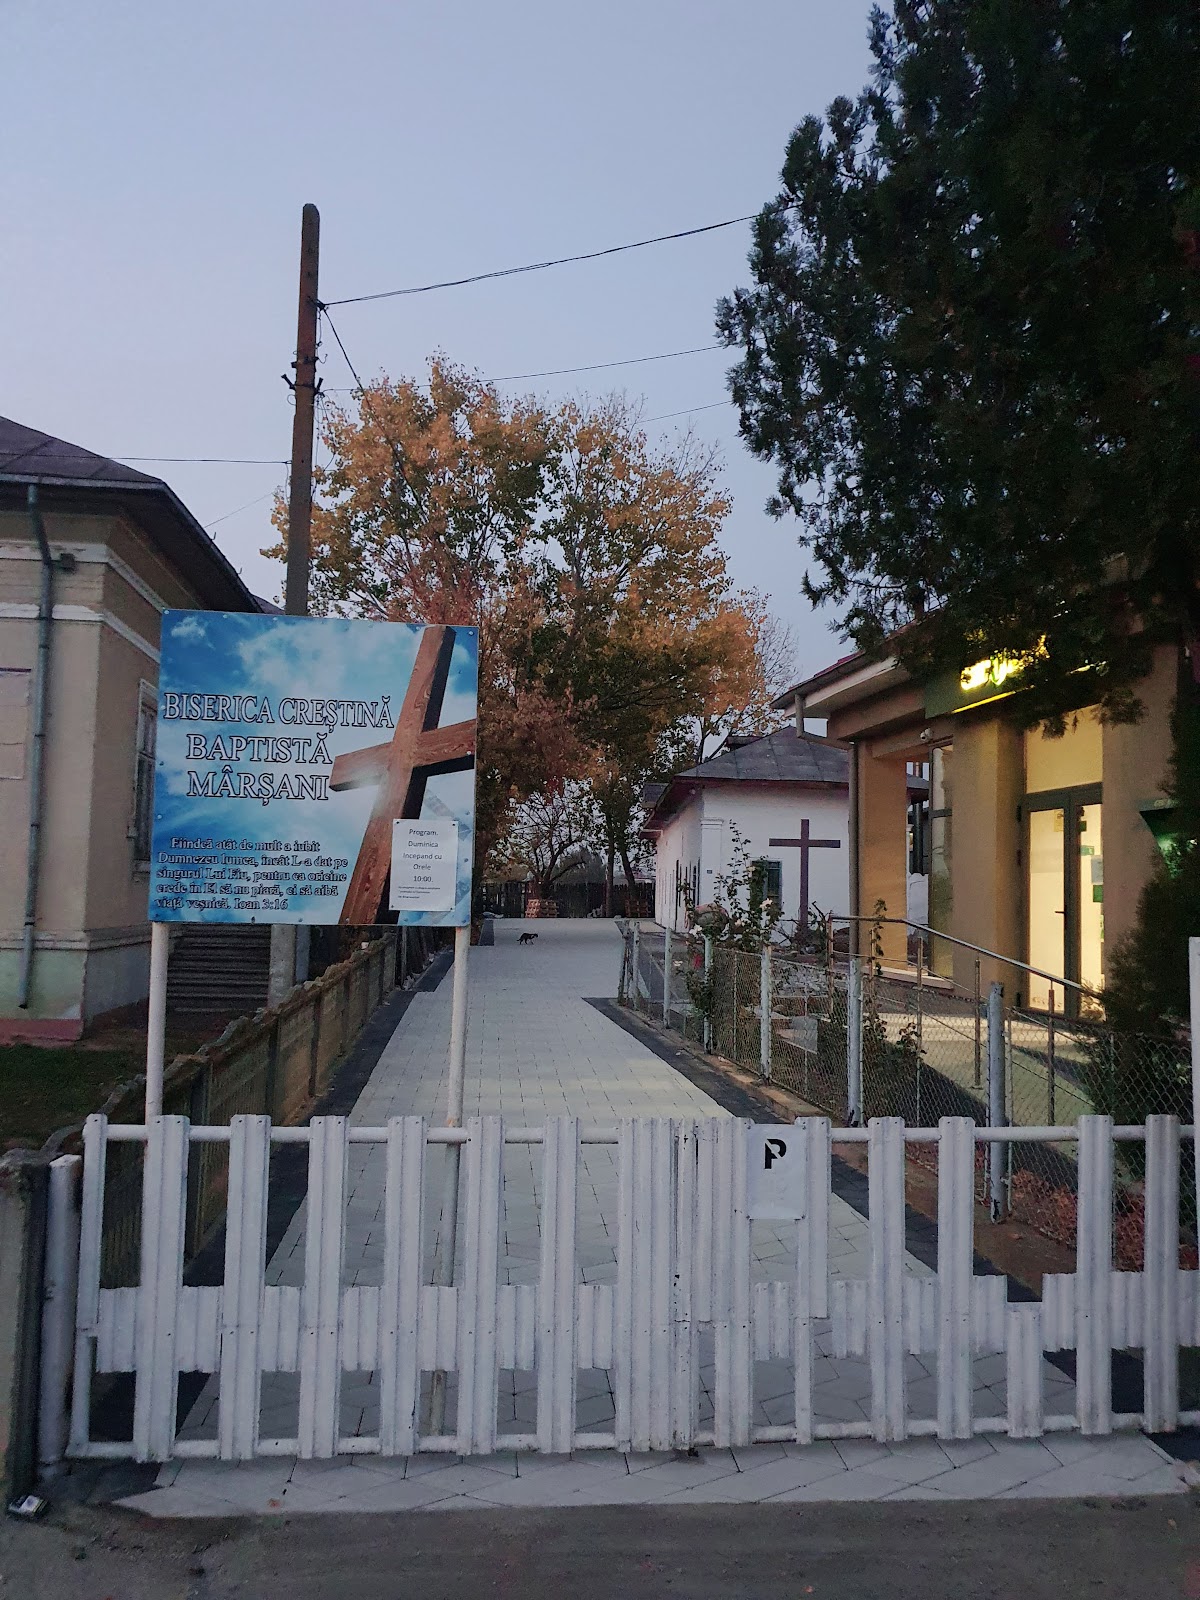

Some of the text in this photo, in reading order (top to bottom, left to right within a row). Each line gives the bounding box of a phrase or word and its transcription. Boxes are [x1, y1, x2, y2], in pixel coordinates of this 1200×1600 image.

[164, 693, 275, 724] BISERICA
[186, 733, 333, 765] BAPTISTĂ
[240, 839, 253, 850] de
[255, 840, 282, 851] mult
[284, 843, 292, 852] a
[294, 840, 320, 852] iubit
[158, 852, 219, 864] Dumnezeu
[221, 853, 259, 867] lumea,
[291, 855, 312, 866] L-a
[314, 856, 333, 867] dat
[333, 858, 348, 869] pe
[157, 866, 347, 882] singurul Lui Fiu, pentru ca oricine
[156, 882, 187, 894] crede
[203, 883, 217, 895] El
[219, 884, 232, 895] să
[234, 885, 249, 895] nu
[286, 884, 297, 896] ci
[234, 898, 260, 909] Ioan
[261, 899, 288, 910] 3:16
[764, 1138, 787, 1170] P
